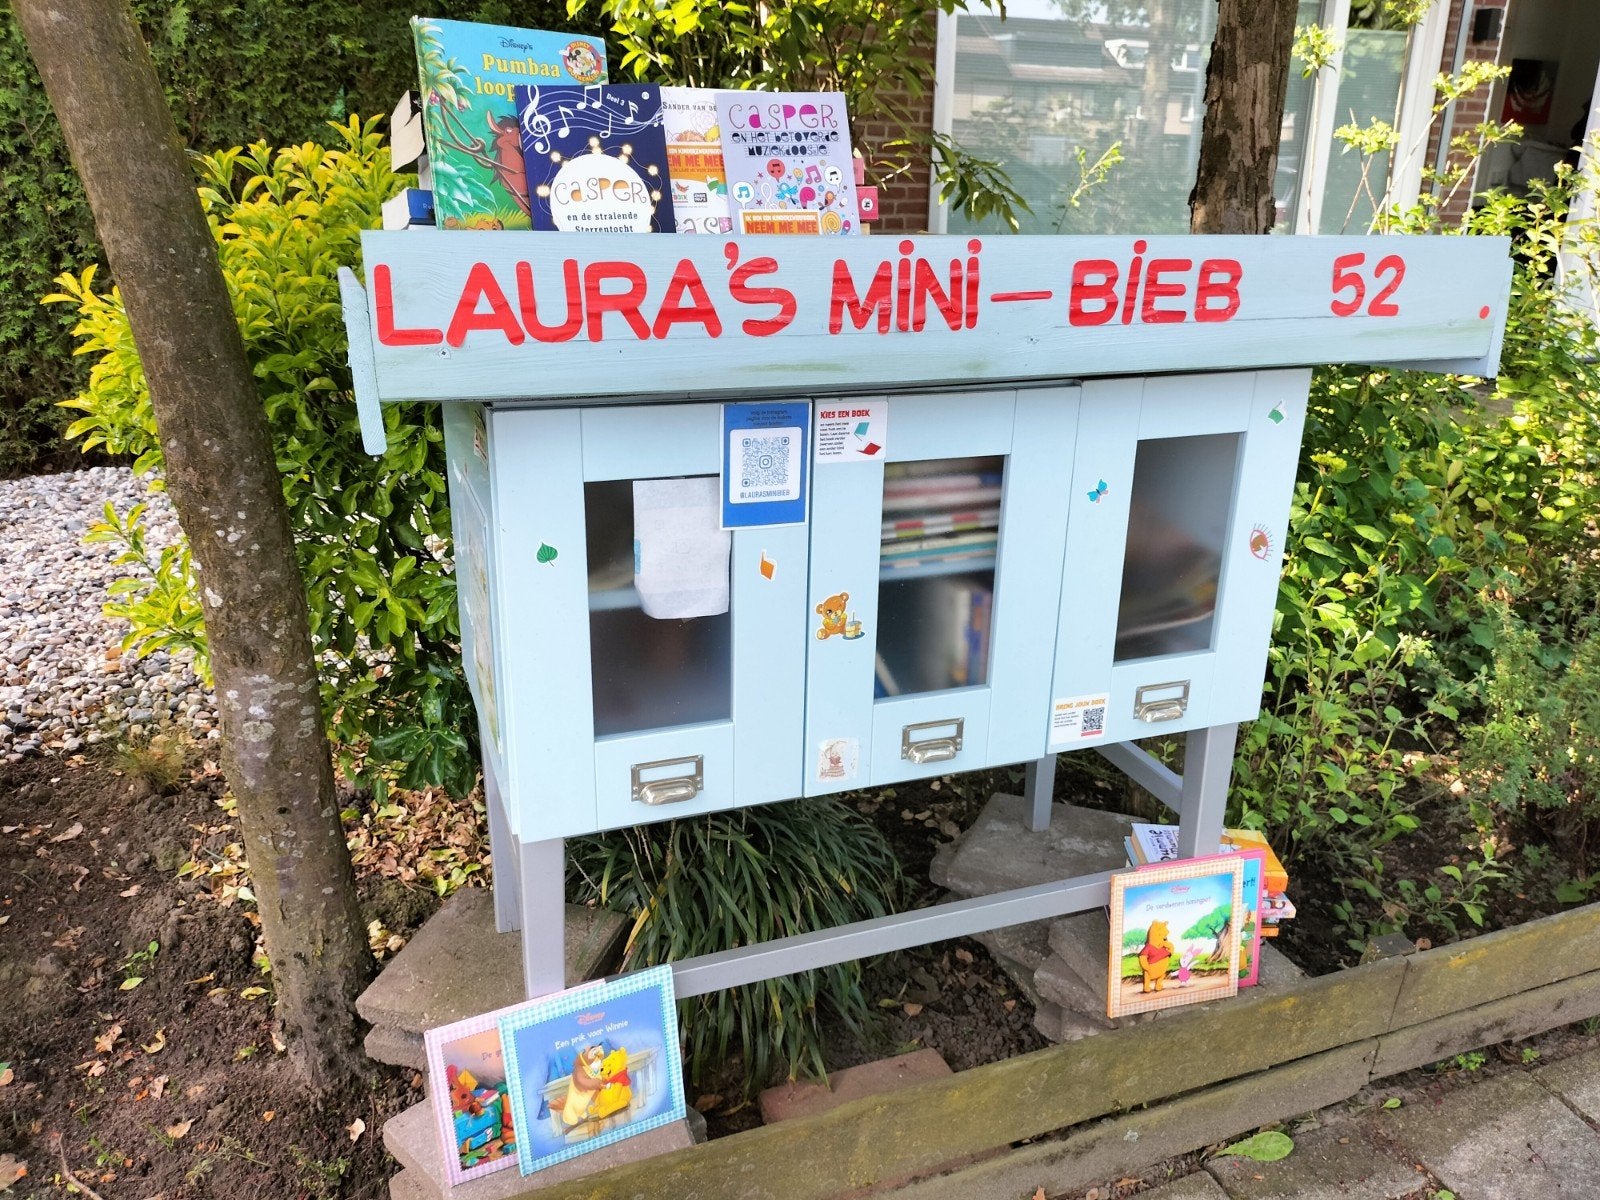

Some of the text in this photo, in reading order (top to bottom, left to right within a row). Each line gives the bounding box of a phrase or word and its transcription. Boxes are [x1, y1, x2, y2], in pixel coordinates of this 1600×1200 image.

[497, 36, 534, 53] Disney's
[482, 53, 561, 78] Pumbaa
[606, 93, 620, 104] Deel
[662, 101, 690, 110] SANDER
[668, 154, 724, 167] EM ME MEE
[581, 212, 591, 221] de
[595, 211, 638, 221] stralende
[575, 224, 634, 233] Sterrentocht
[746, 221, 818, 234] NEEM ME MEE
[373, 241, 798, 348] LAURA'S
[1330, 252, 1406, 318] 52
[820, 409, 871, 419] KIES EEN BOEK
[1146, 904, 1154, 912] De
[555, 1019, 629, 1050] Een prik voor Winnie
[481, 1051, 492, 1061] De
